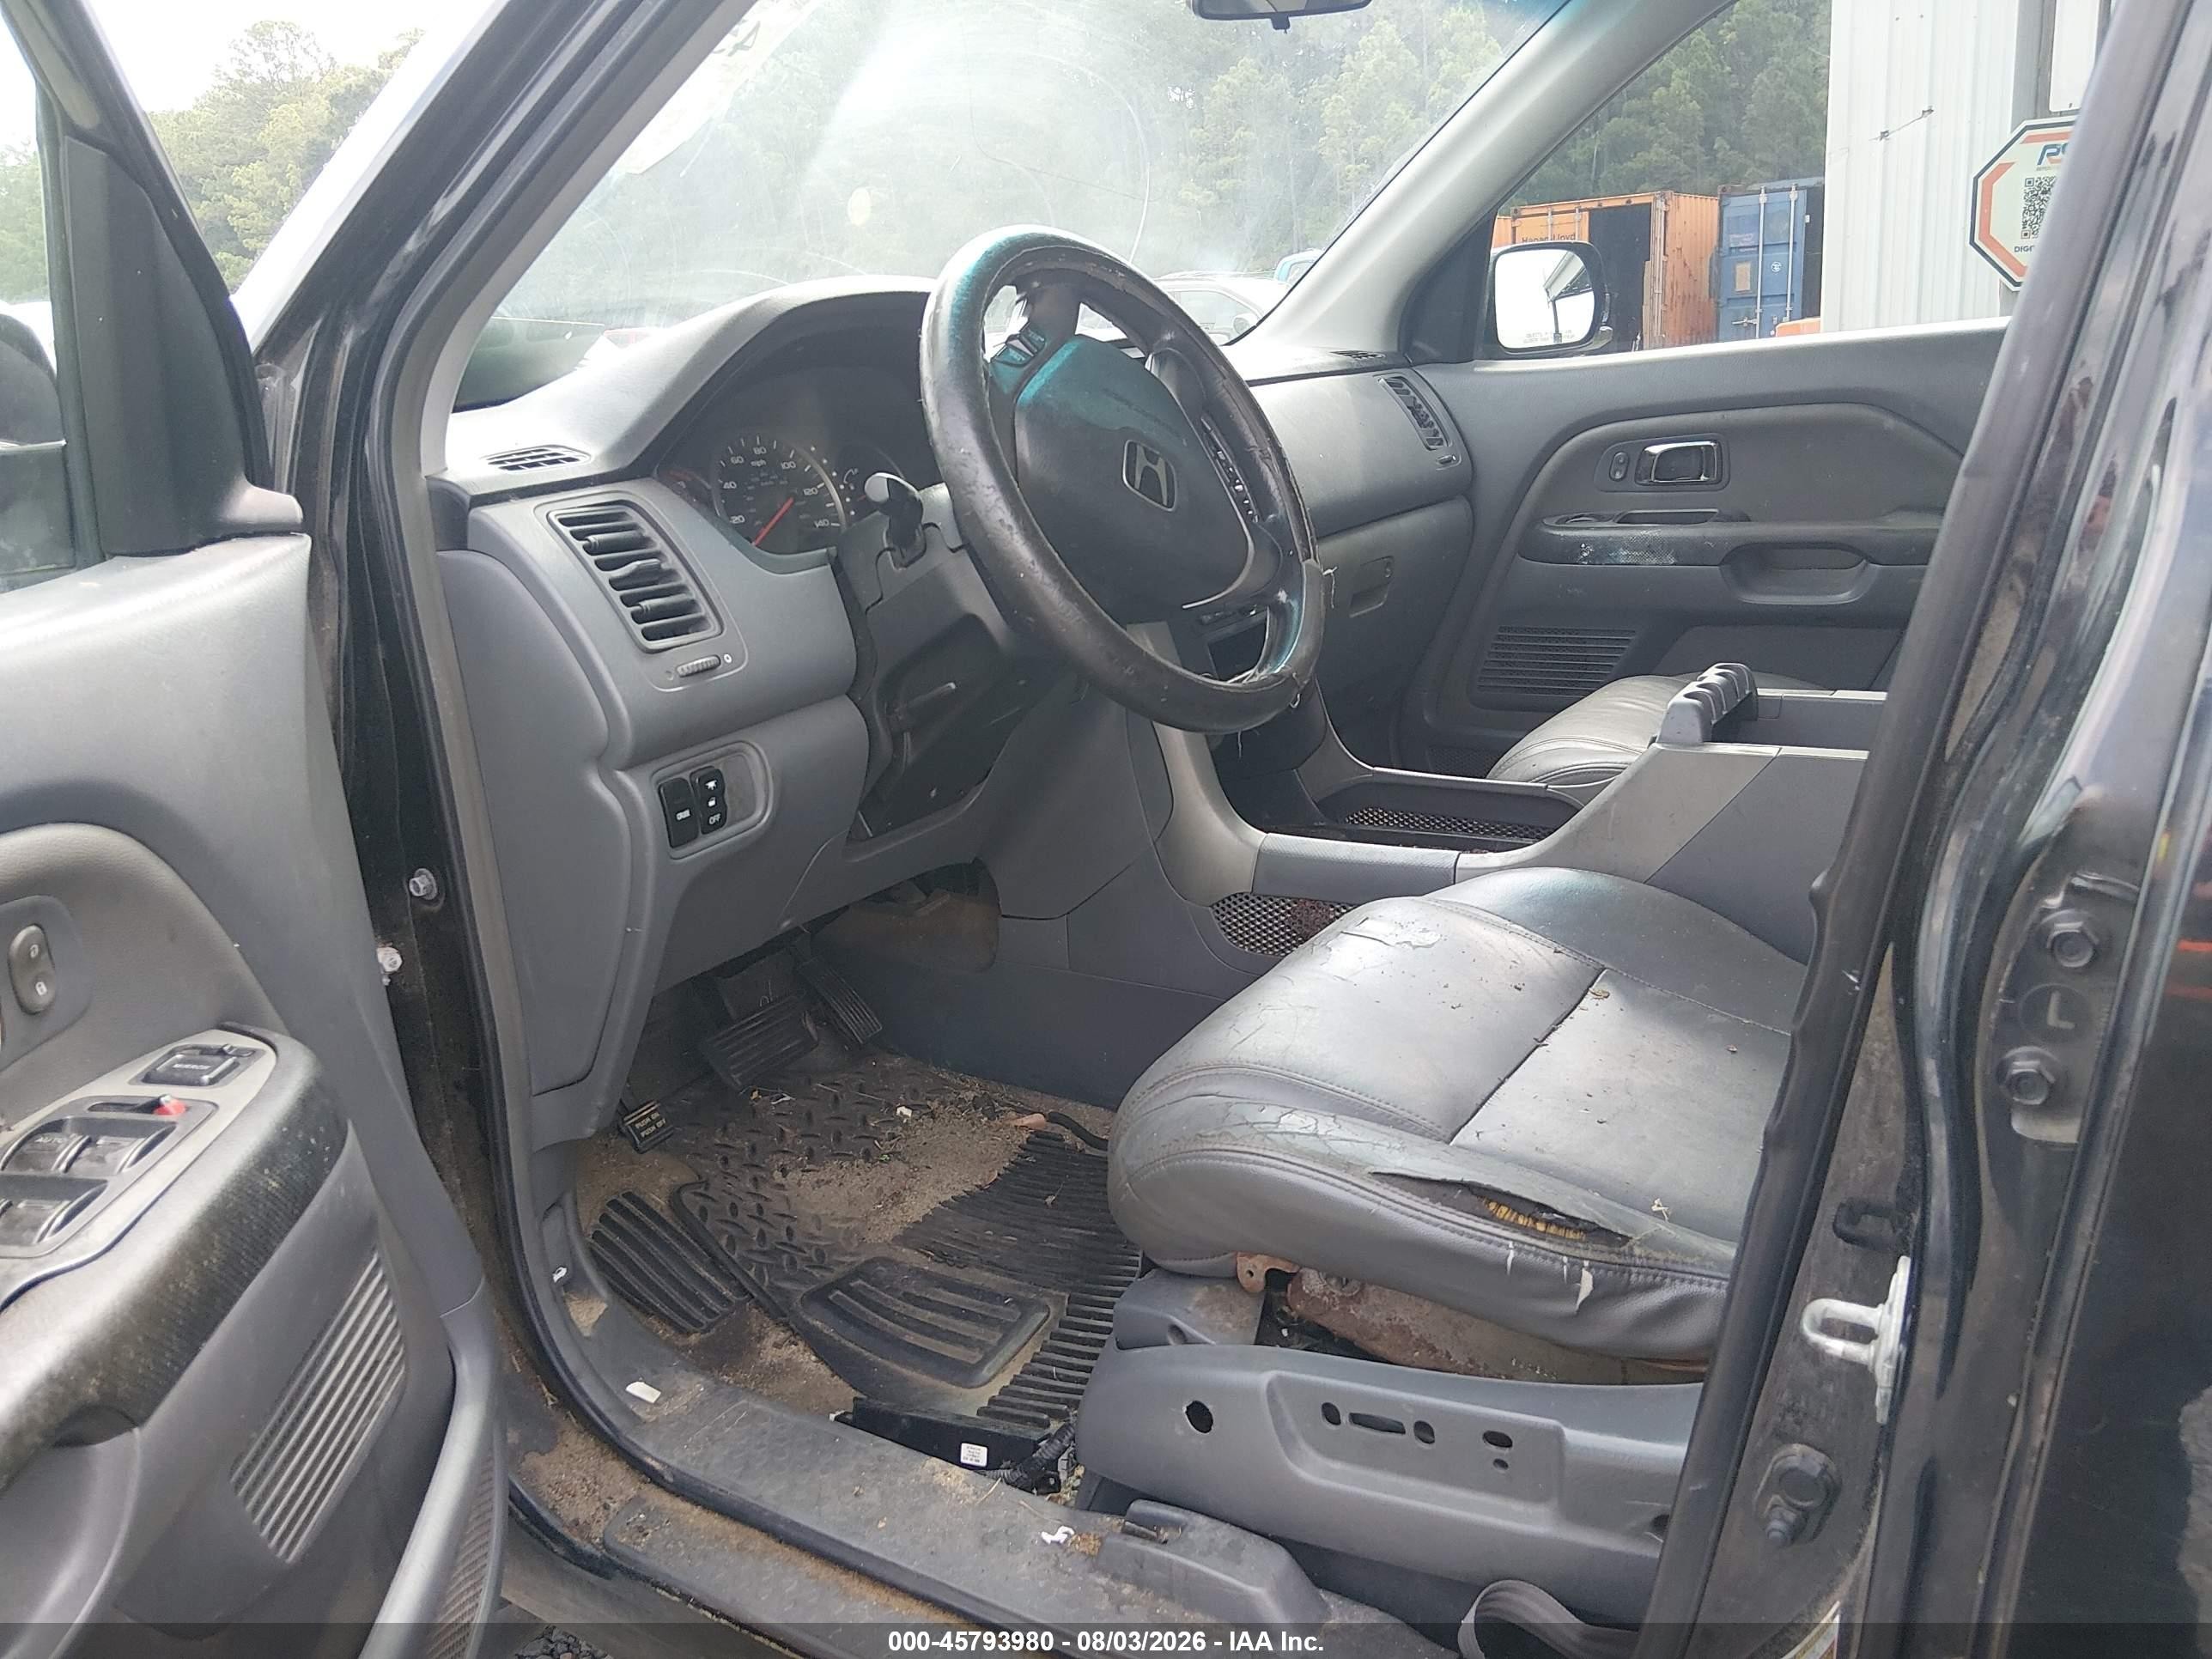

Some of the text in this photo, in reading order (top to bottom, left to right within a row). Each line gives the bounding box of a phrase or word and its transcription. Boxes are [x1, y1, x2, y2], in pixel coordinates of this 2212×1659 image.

[753, 447, 767, 455] 80
[731, 456, 744, 465] 60
[780, 460, 797, 470] 100
[723, 481, 737, 489] 40
[803, 487, 818, 496] 120
[731, 514, 745, 525] 20
[813, 519, 830, 528] 140
[708, 812, 722, 825] OFF
[640, 1125, 657, 1139] PUSH
